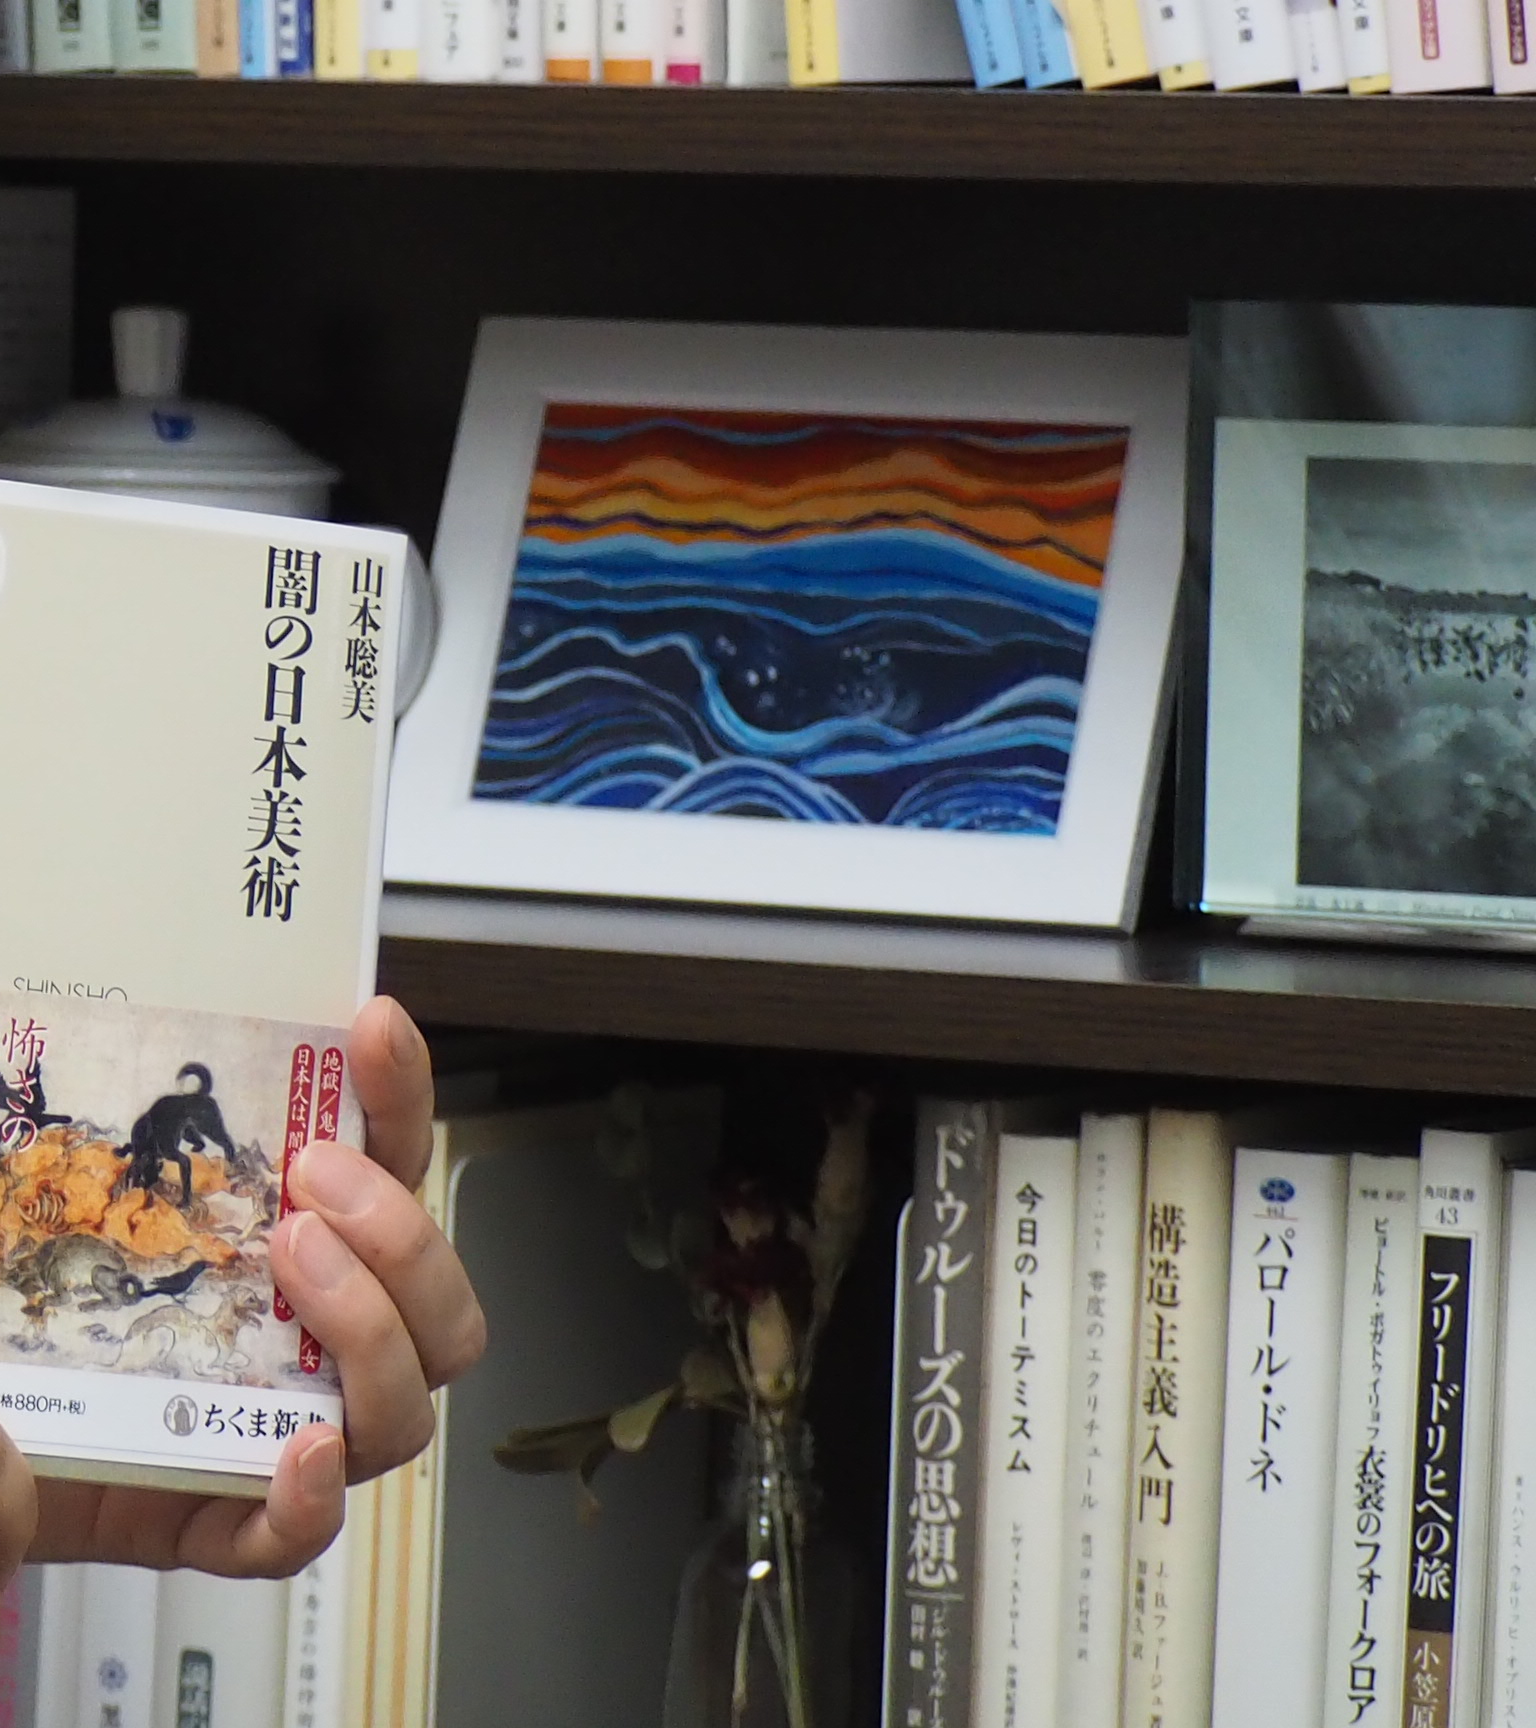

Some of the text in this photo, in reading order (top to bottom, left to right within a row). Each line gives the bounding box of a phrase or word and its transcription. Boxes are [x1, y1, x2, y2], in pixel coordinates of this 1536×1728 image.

[240, 544, 323, 923] 闇の日本美術
[340, 557, 385, 725] 山本聡美
[0, 1015, 48, 1153] 怖さの
[1423, 1184, 1476, 1203] 角川叢書
[1434, 1205, 1460, 1226] 43
[907, 1122, 976, 1588] ドゥルーズの思想
[1006, 1181, 1045, 1474] 今日のトーテミスム
[1081, 1269, 1109, 1509] 零度のエクリチュール
[1138, 1201, 1187, 1526] 構造主義入門
[1247, 1226, 1296, 1493] パロール・ドネ
[1412, 1270, 1461, 1601] フリードリヒへの旅
[1347, 1445, 1387, 1725] 衣裳のフォークロア
